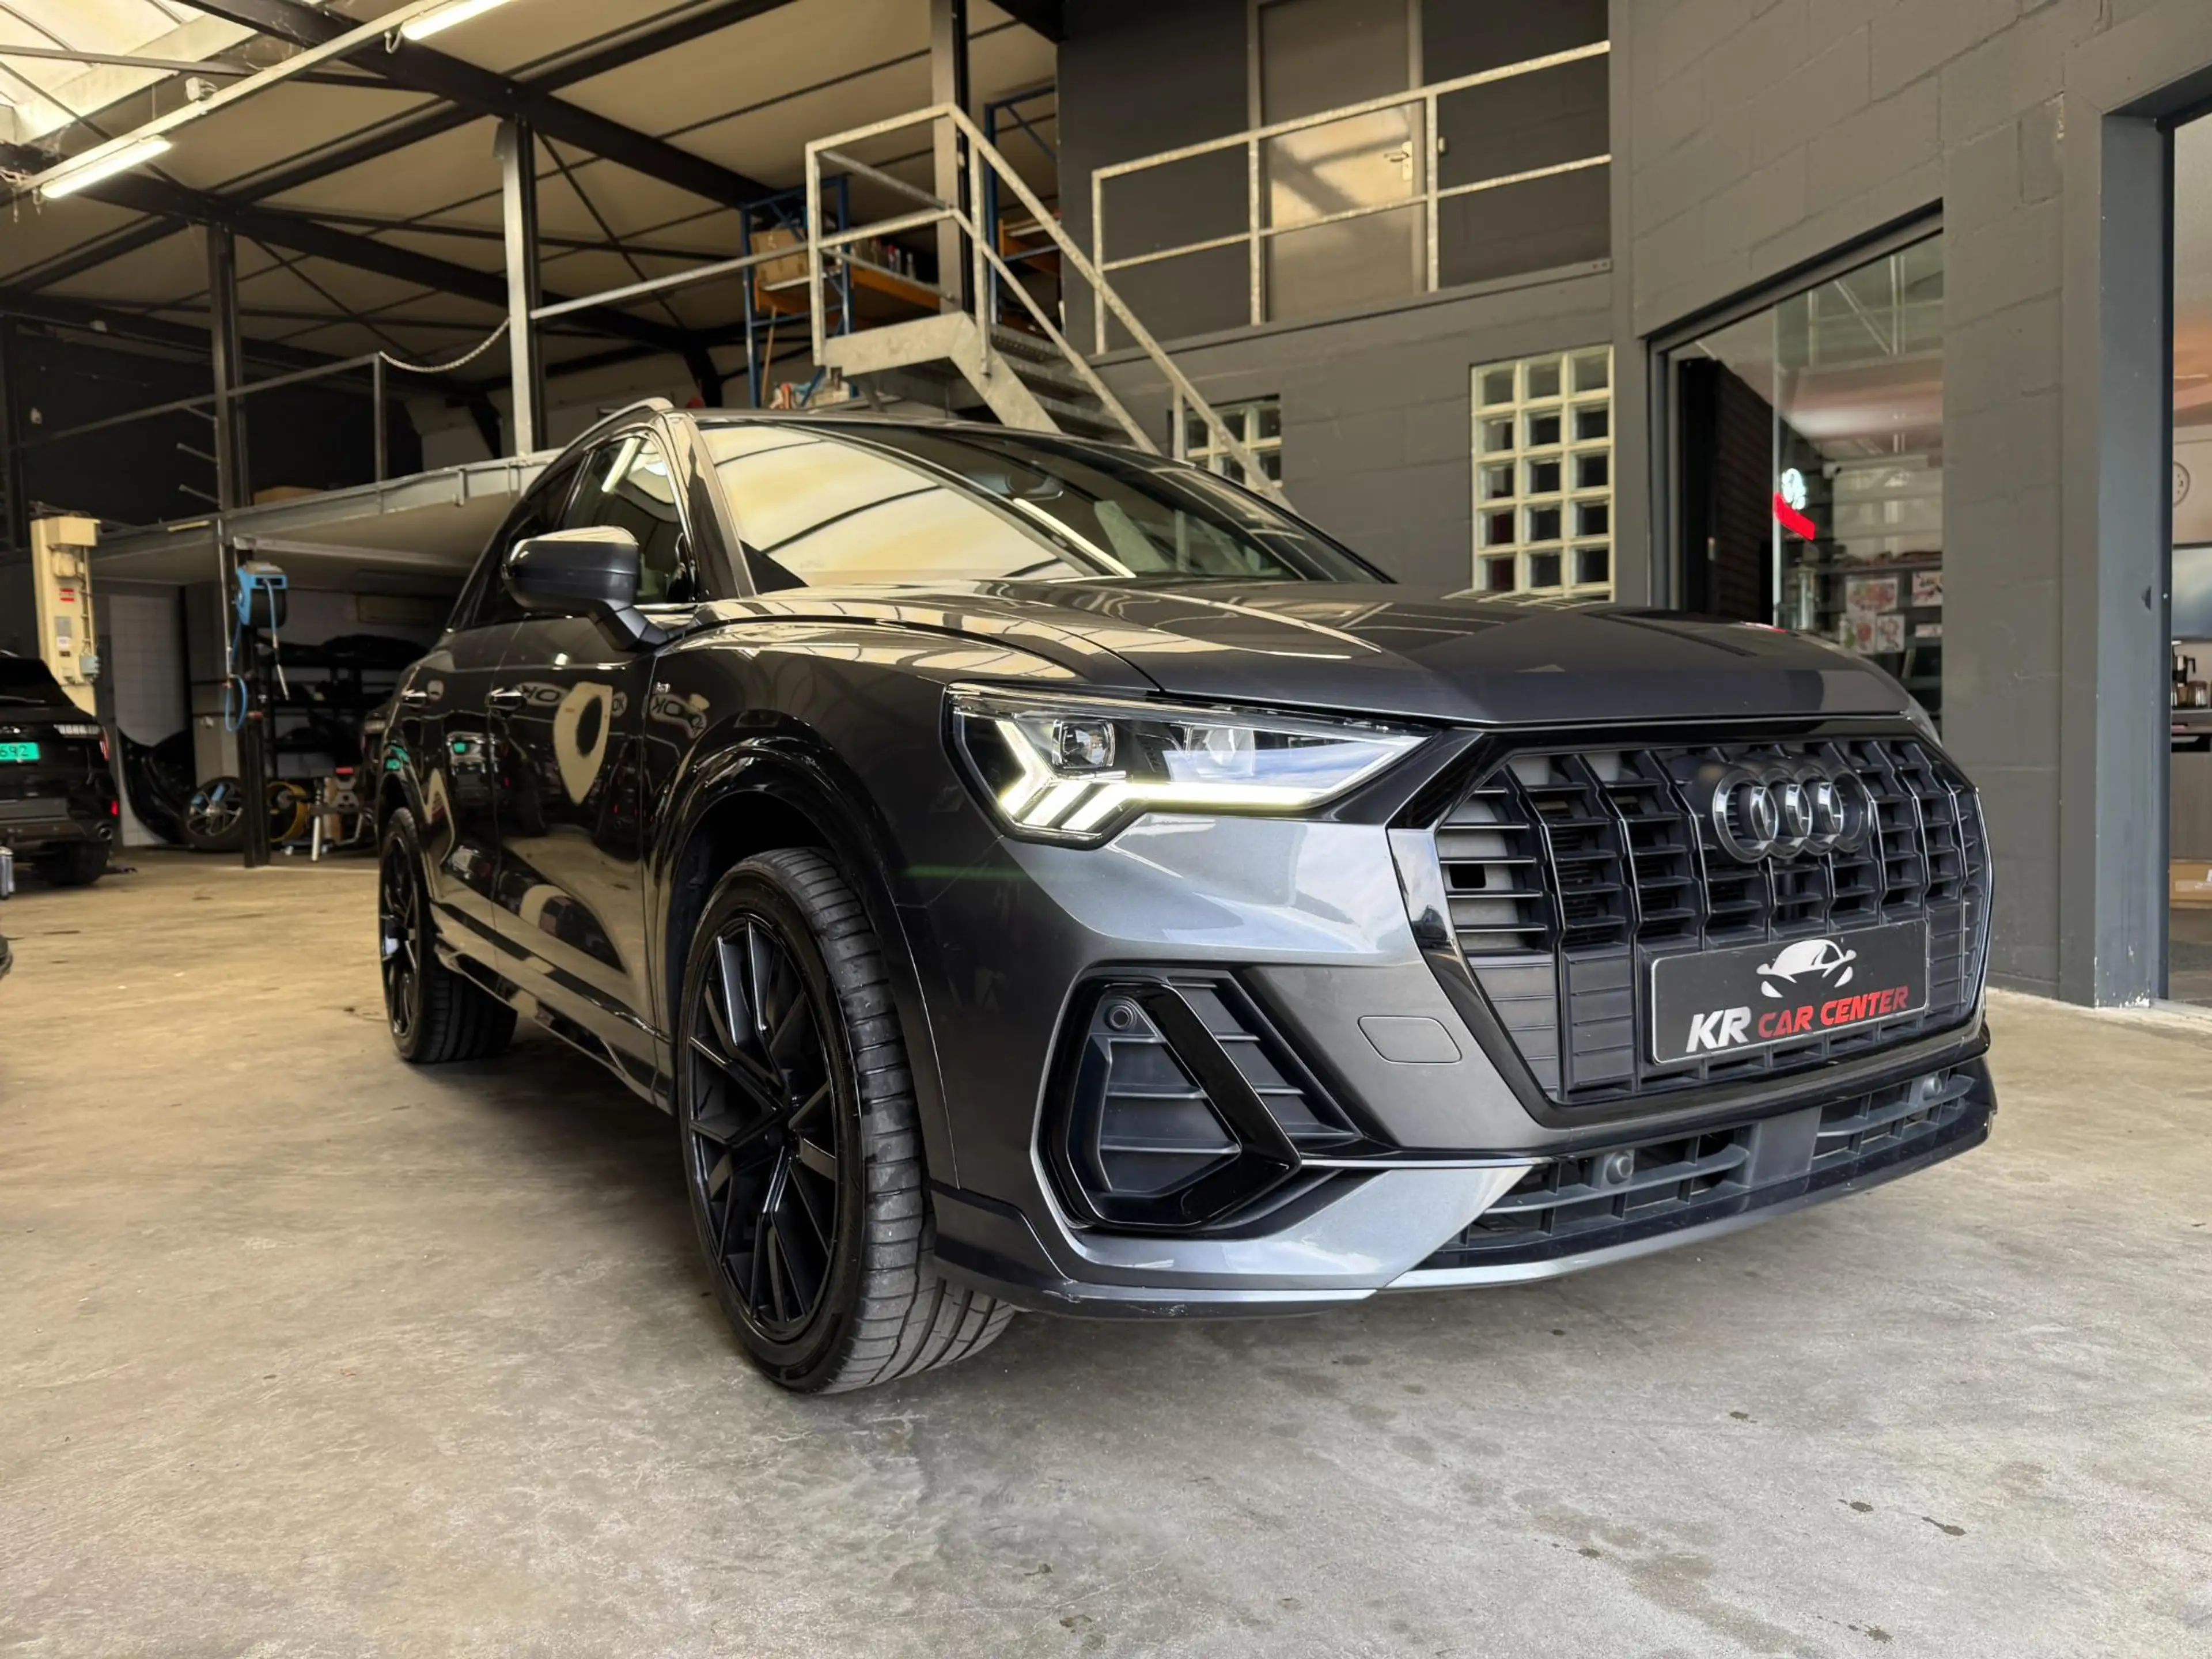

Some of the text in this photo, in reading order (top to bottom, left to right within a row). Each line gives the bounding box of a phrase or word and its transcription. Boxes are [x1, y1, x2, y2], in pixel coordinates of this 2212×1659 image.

[1686, 985, 1909, 1053] KR CAR CENTER
